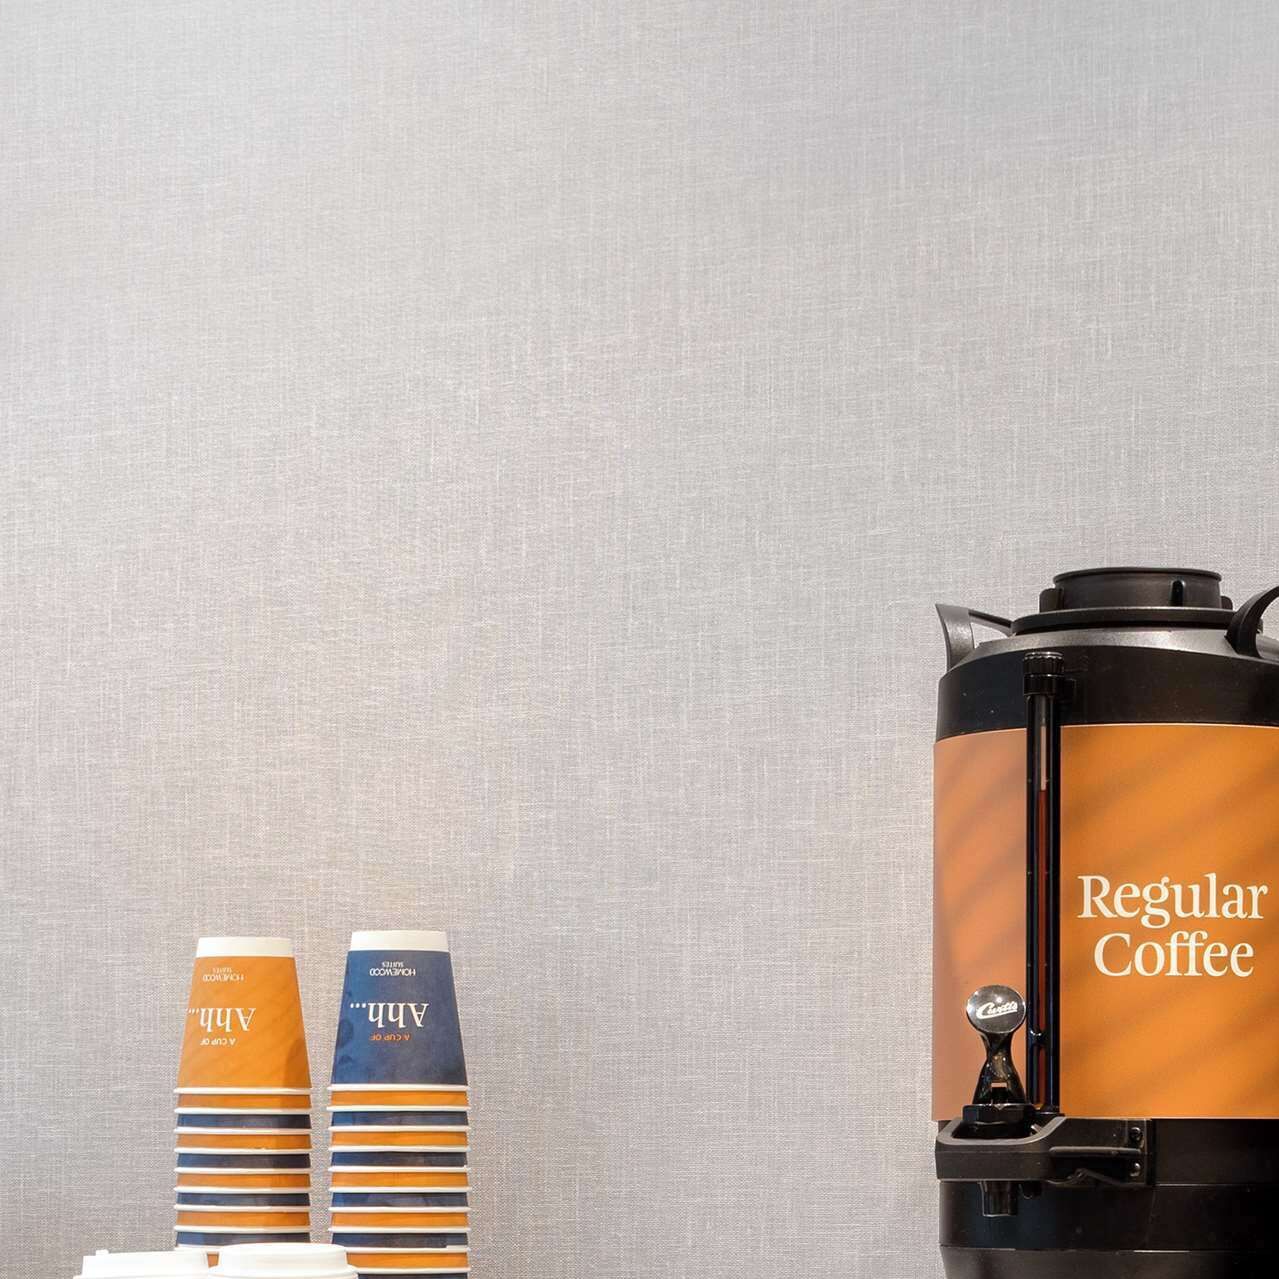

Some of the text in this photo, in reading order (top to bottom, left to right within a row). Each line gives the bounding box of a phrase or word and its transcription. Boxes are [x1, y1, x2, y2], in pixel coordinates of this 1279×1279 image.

[1076, 873, 1268, 930] Regular
[1093, 932, 1255, 978] Coffee
[369, 967, 417, 977] HOMEWOOD
[350, 1002, 430, 1029] Ahh...
[200, 1037, 210, 1046] OF
[210, 1037, 228, 1046] CUP
[369, 1033, 382, 1041] OF
[384, 1033, 402, 1041] CUP
